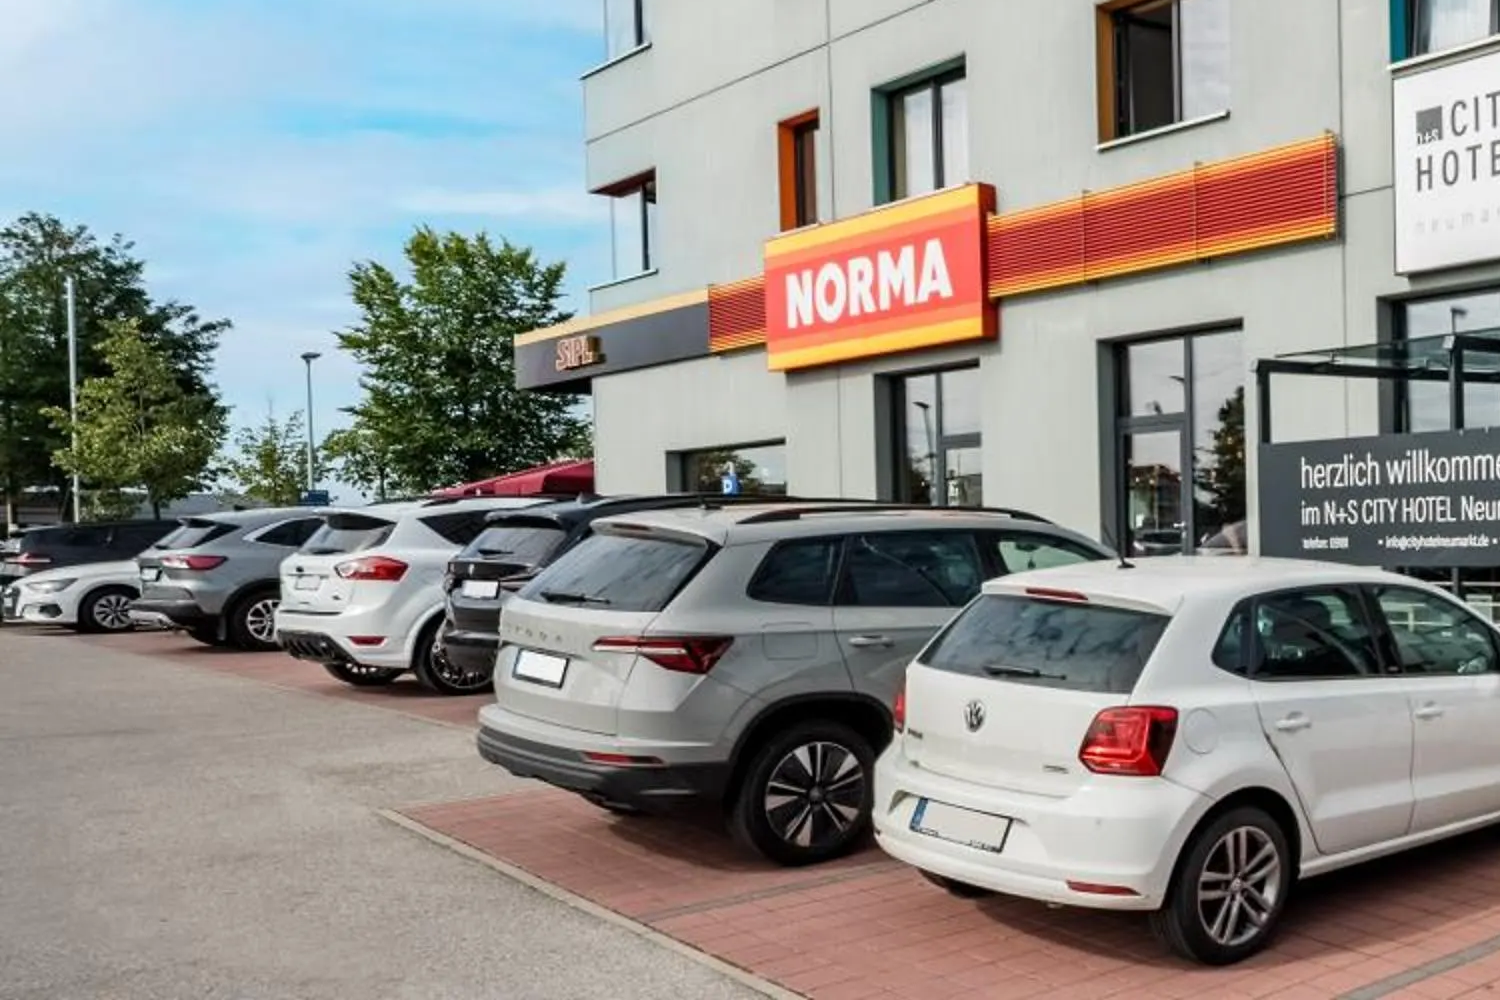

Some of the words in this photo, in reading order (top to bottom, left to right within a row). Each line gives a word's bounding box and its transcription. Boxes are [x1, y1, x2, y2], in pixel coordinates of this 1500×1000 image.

[786, 238, 953, 329] NORMA
[1301, 453, 1381, 489] herzlich
[1301, 501, 1321, 526] im
[1324, 499, 1359, 526] N+S
[1361, 498, 1400, 523] CITY
[1402, 496, 1456, 523] HOTEL
